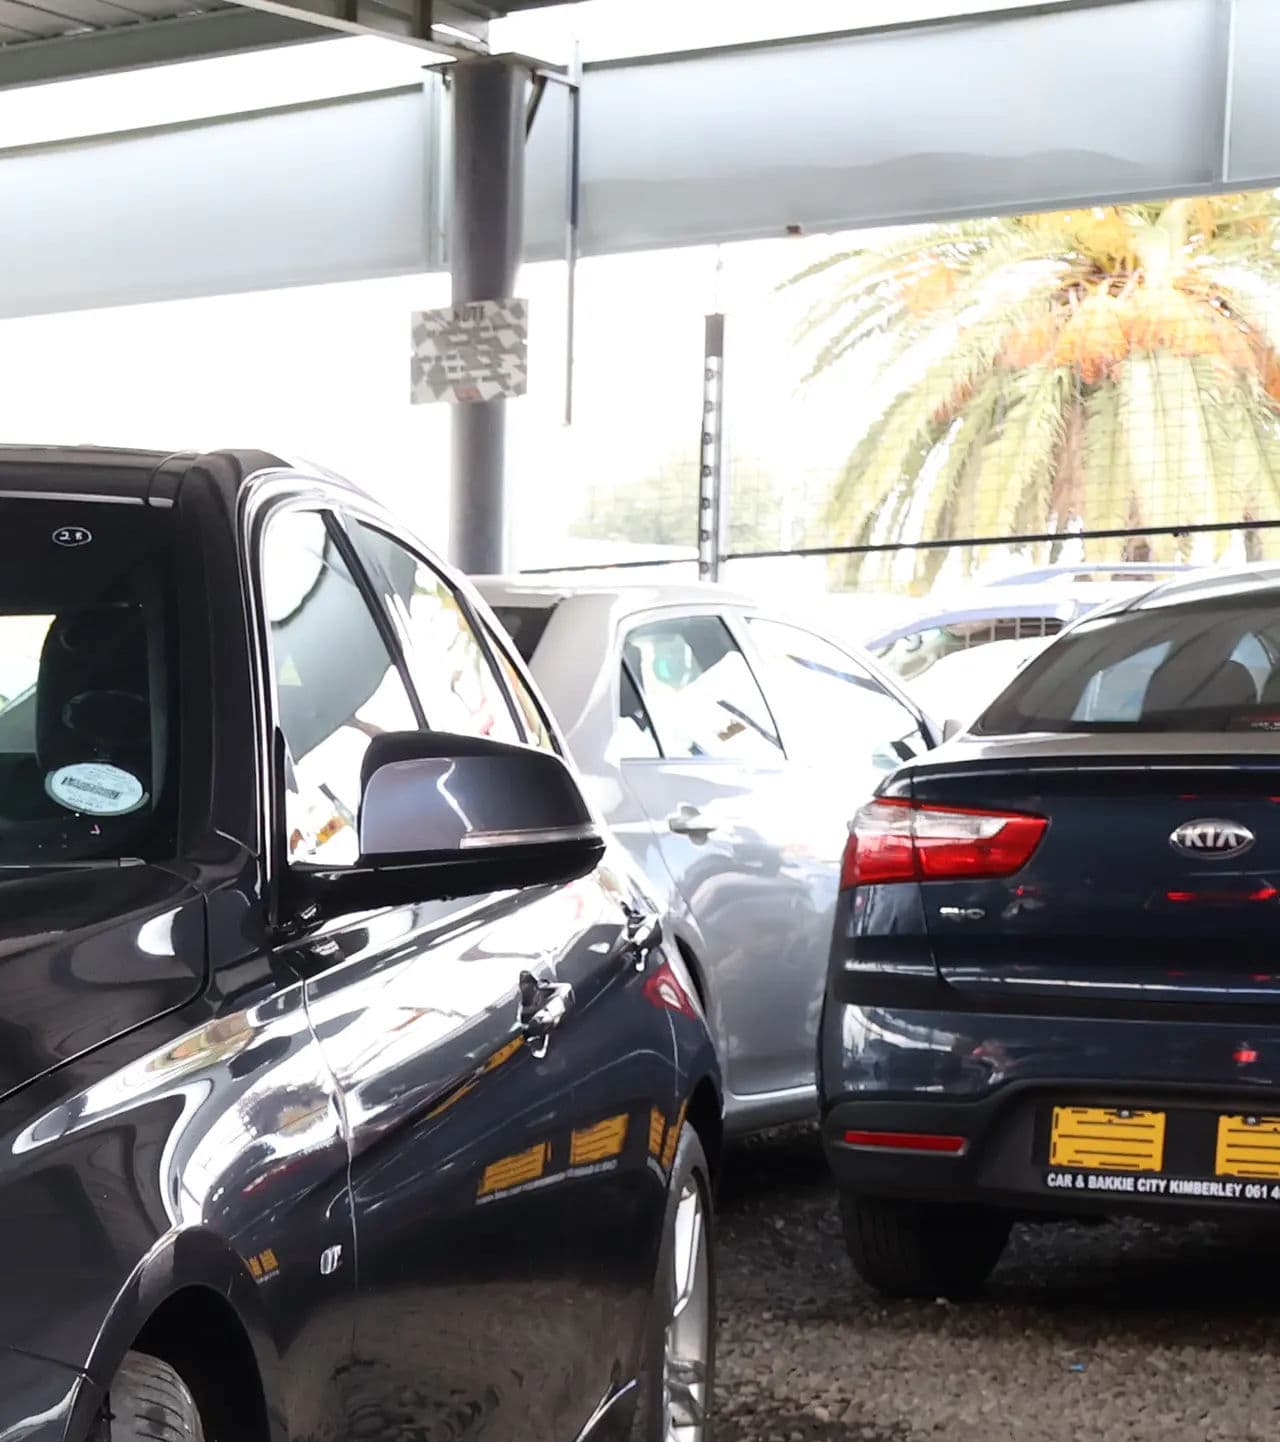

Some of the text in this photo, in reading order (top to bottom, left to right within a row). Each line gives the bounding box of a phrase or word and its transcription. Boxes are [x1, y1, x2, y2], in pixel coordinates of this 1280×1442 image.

[1183, 825, 1238, 848] KIA
[1047, 1173, 1073, 1188] CAR
[1075, 1174, 1085, 1188] &
[1087, 1176, 1134, 1191] BAKKIE
[1137, 1178, 1167, 1193] CITY
[1169, 1180, 1242, 1198] KIMBERLEY
[1245, 1183, 1268, 1199] 061
